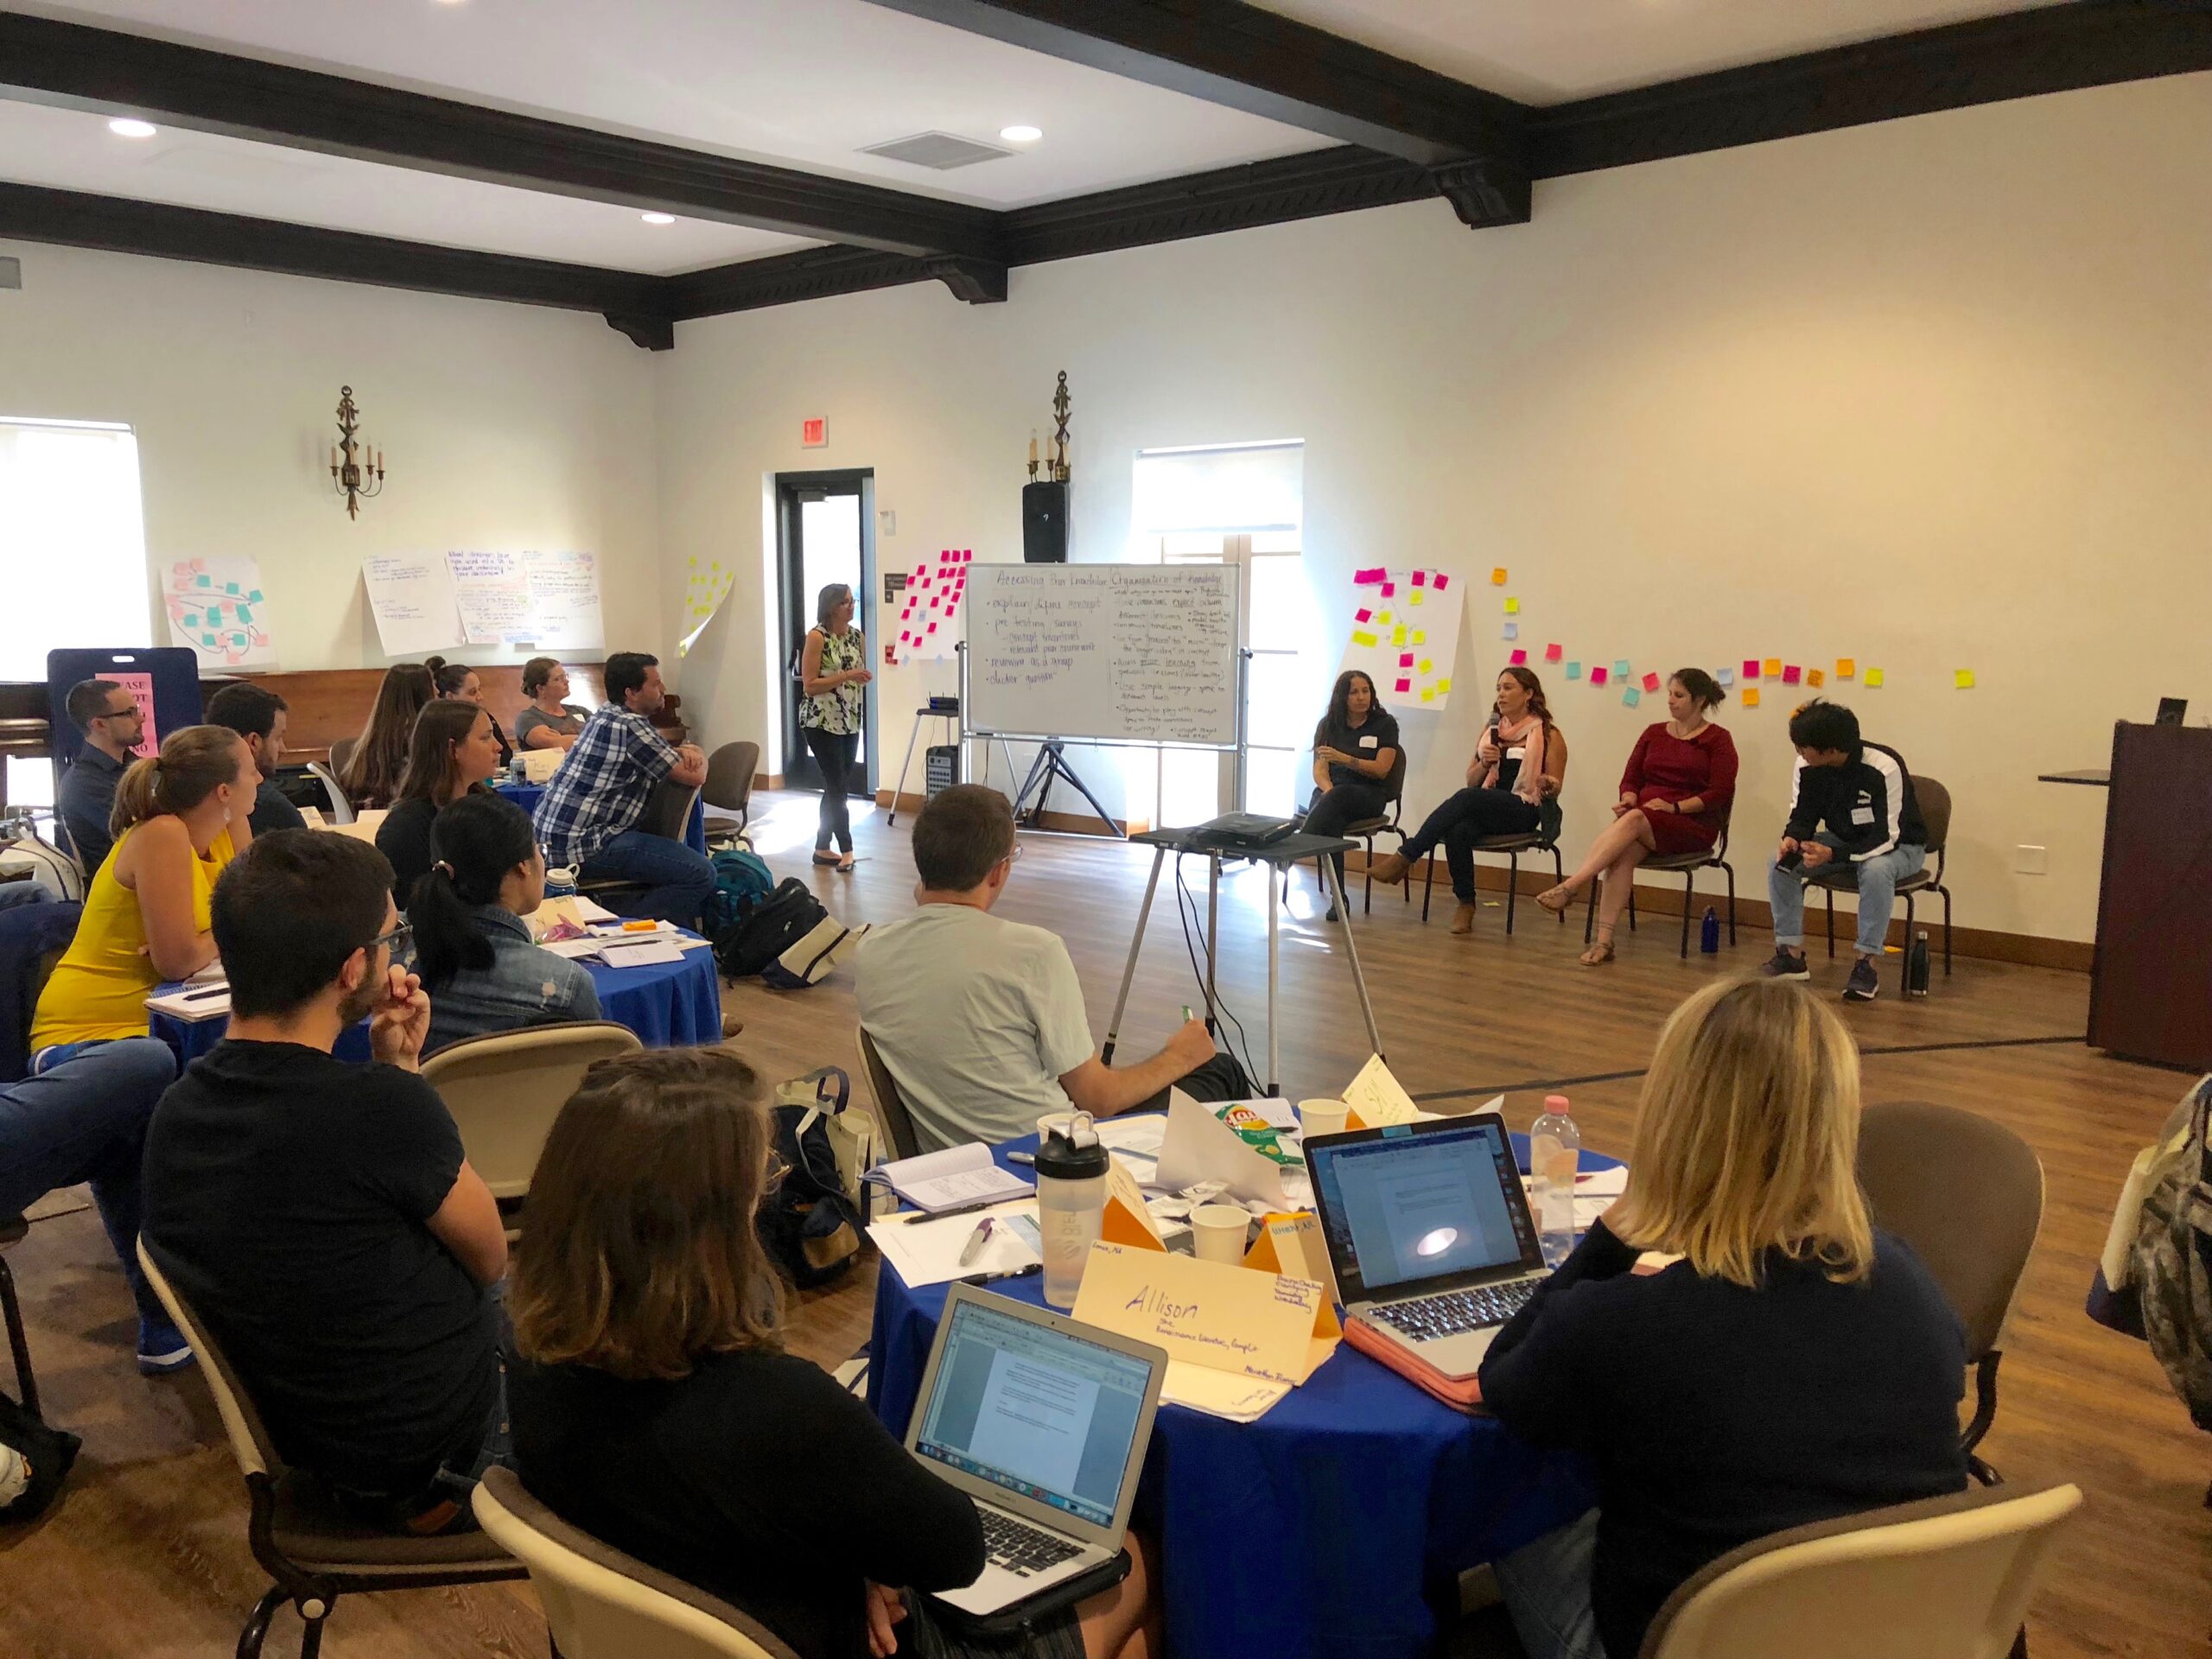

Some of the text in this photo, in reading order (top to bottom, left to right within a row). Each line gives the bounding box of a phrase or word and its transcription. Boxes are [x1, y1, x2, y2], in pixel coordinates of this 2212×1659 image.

[804, 420, 822, 442] EXIT
[997, 569, 1044, 587] Accessing
[1126, 1285, 1198, 1319] Allison
